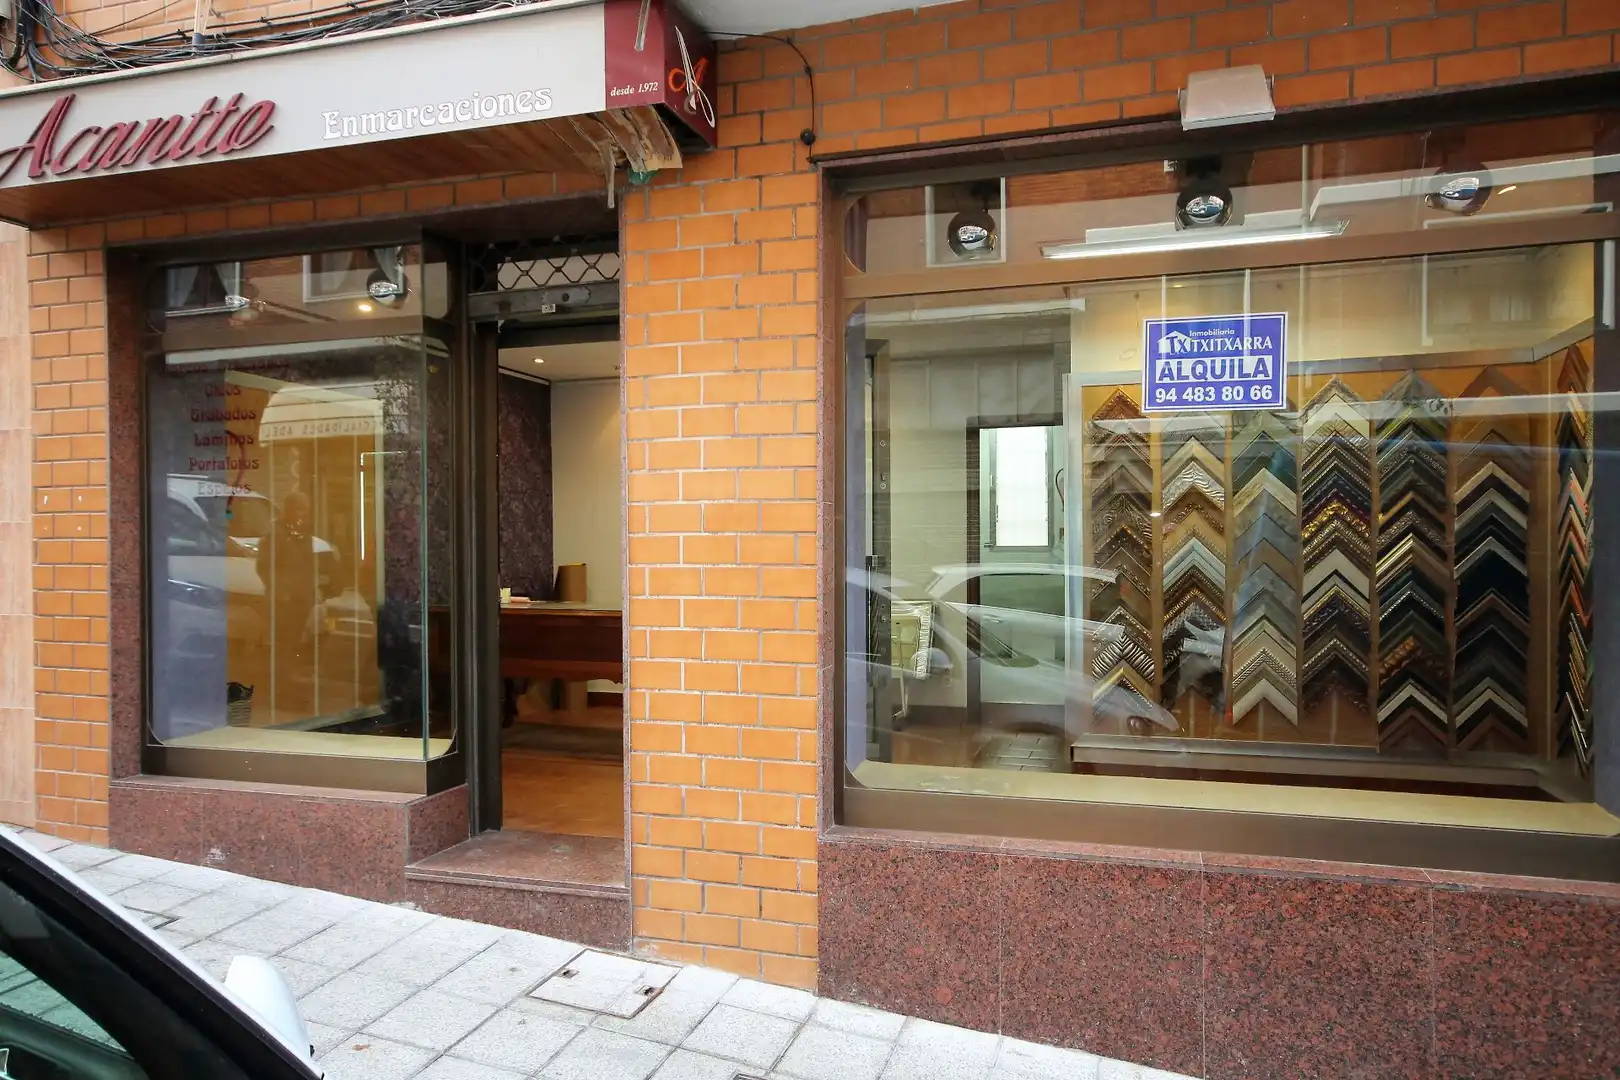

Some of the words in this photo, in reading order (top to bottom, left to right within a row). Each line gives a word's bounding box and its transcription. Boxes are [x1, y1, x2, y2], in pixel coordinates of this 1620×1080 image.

[610, 84, 635, 97] desde
[638, 81, 659, 93] 1.972
[321, 87, 553, 141] Enmarcaciones
[1189, 328, 1236, 337] Inmobiliaria
[1191, 335, 1273, 353] TXITXARRA
[1158, 357, 1270, 381] ALQUILA
[1155, 387, 1178, 403] 94
[1182, 386, 1216, 402] 483
[1221, 385, 1244, 401] 80
[1250, 384, 1273, 400] 66
